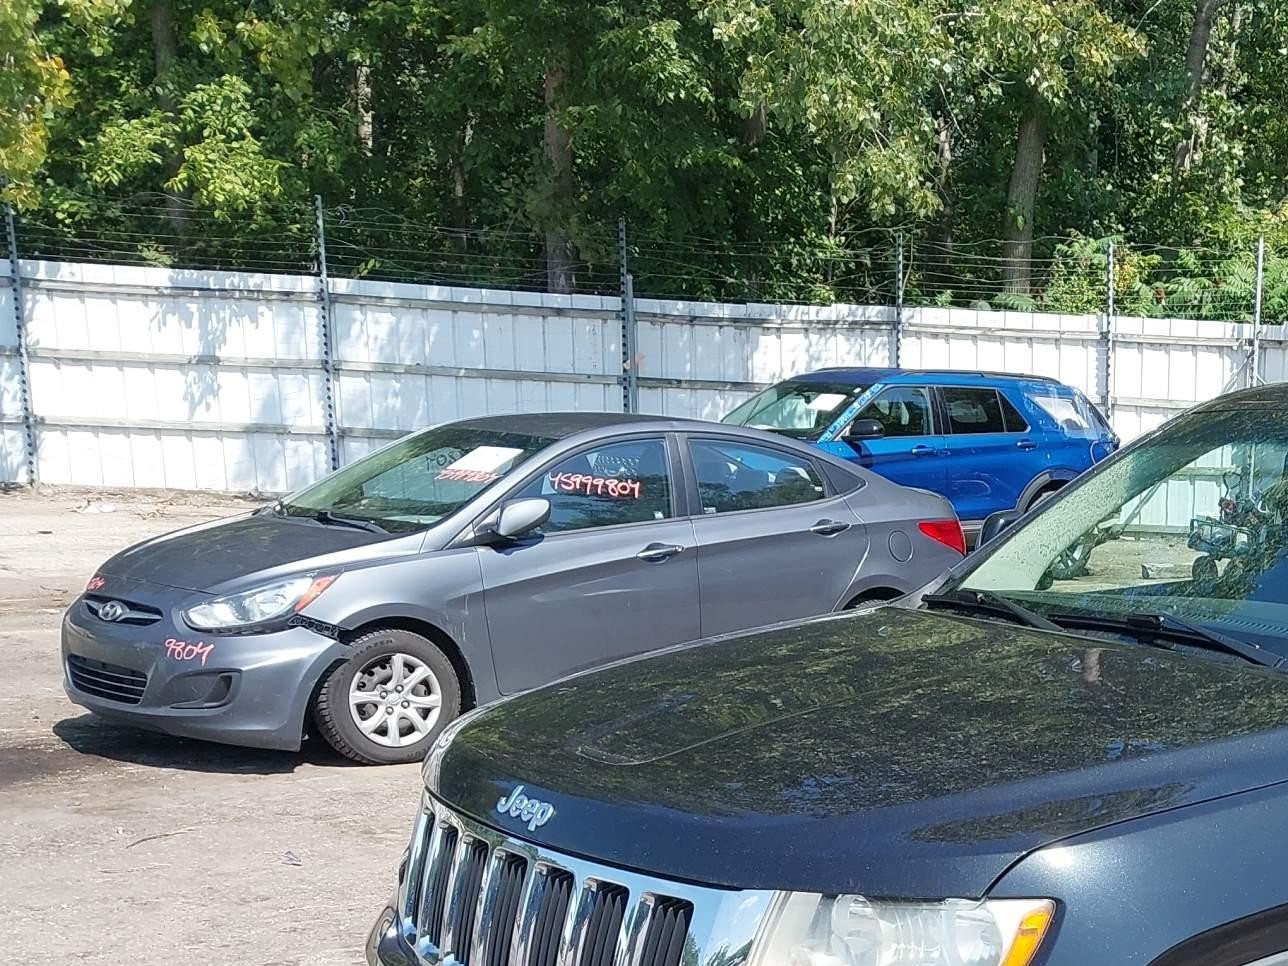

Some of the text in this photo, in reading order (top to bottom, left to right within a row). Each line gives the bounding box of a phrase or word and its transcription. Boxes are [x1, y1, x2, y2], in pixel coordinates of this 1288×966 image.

[548, 471, 640, 499] 45999804
[164, 638, 215, 667] 9804
[496, 784, 555, 832] Jeep
